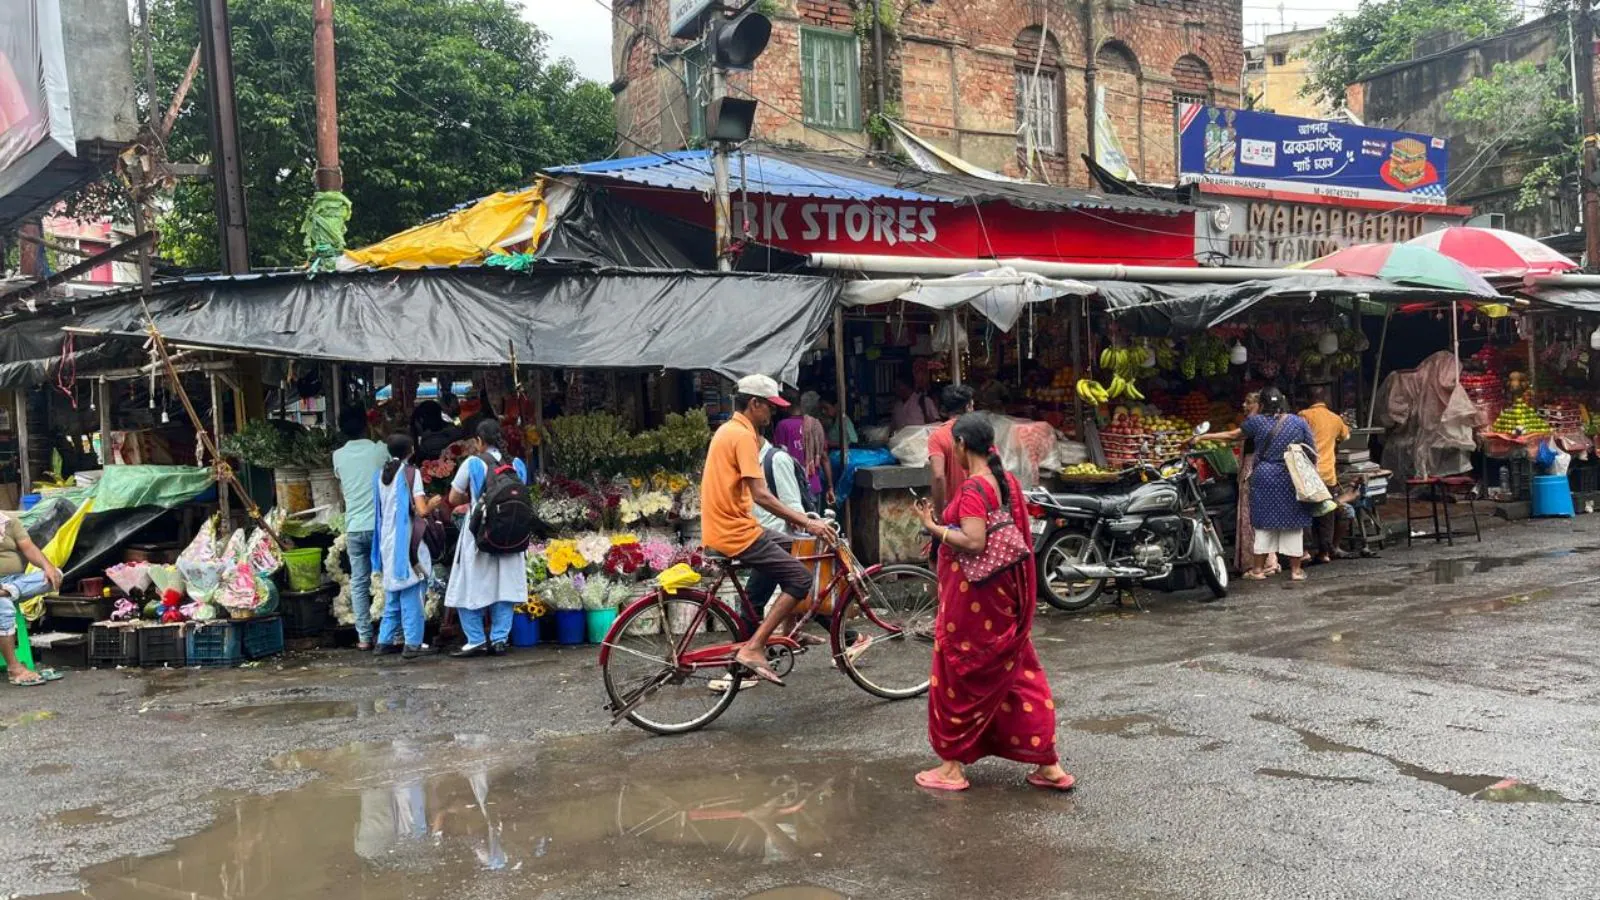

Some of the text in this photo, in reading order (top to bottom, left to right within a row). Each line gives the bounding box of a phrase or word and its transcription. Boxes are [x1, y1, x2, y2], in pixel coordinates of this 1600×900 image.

[733, 201, 937, 246] BK STORES
[1248, 203, 1424, 244] MAHAPRABHU
